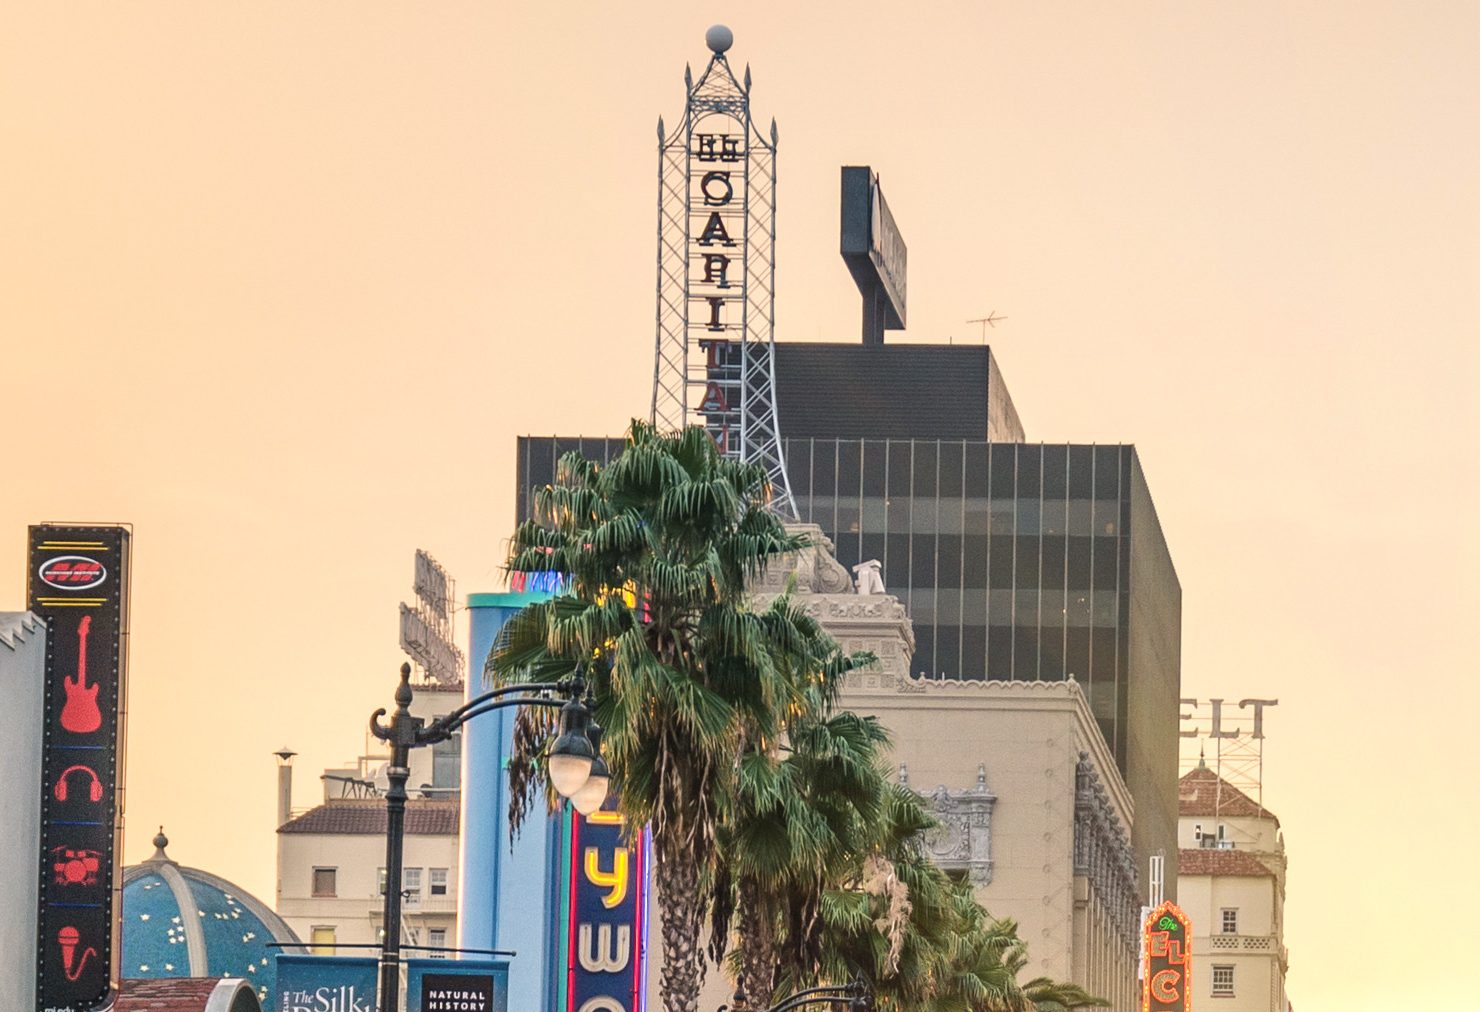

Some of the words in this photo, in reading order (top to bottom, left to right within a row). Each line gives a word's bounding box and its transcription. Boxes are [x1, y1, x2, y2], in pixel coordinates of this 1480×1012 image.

[1150, 931, 1185, 965] EL
[293, 990, 314, 1004] The
[429, 990, 485, 1000] NATURAL
[429, 1001, 485, 1011] HISTORY
